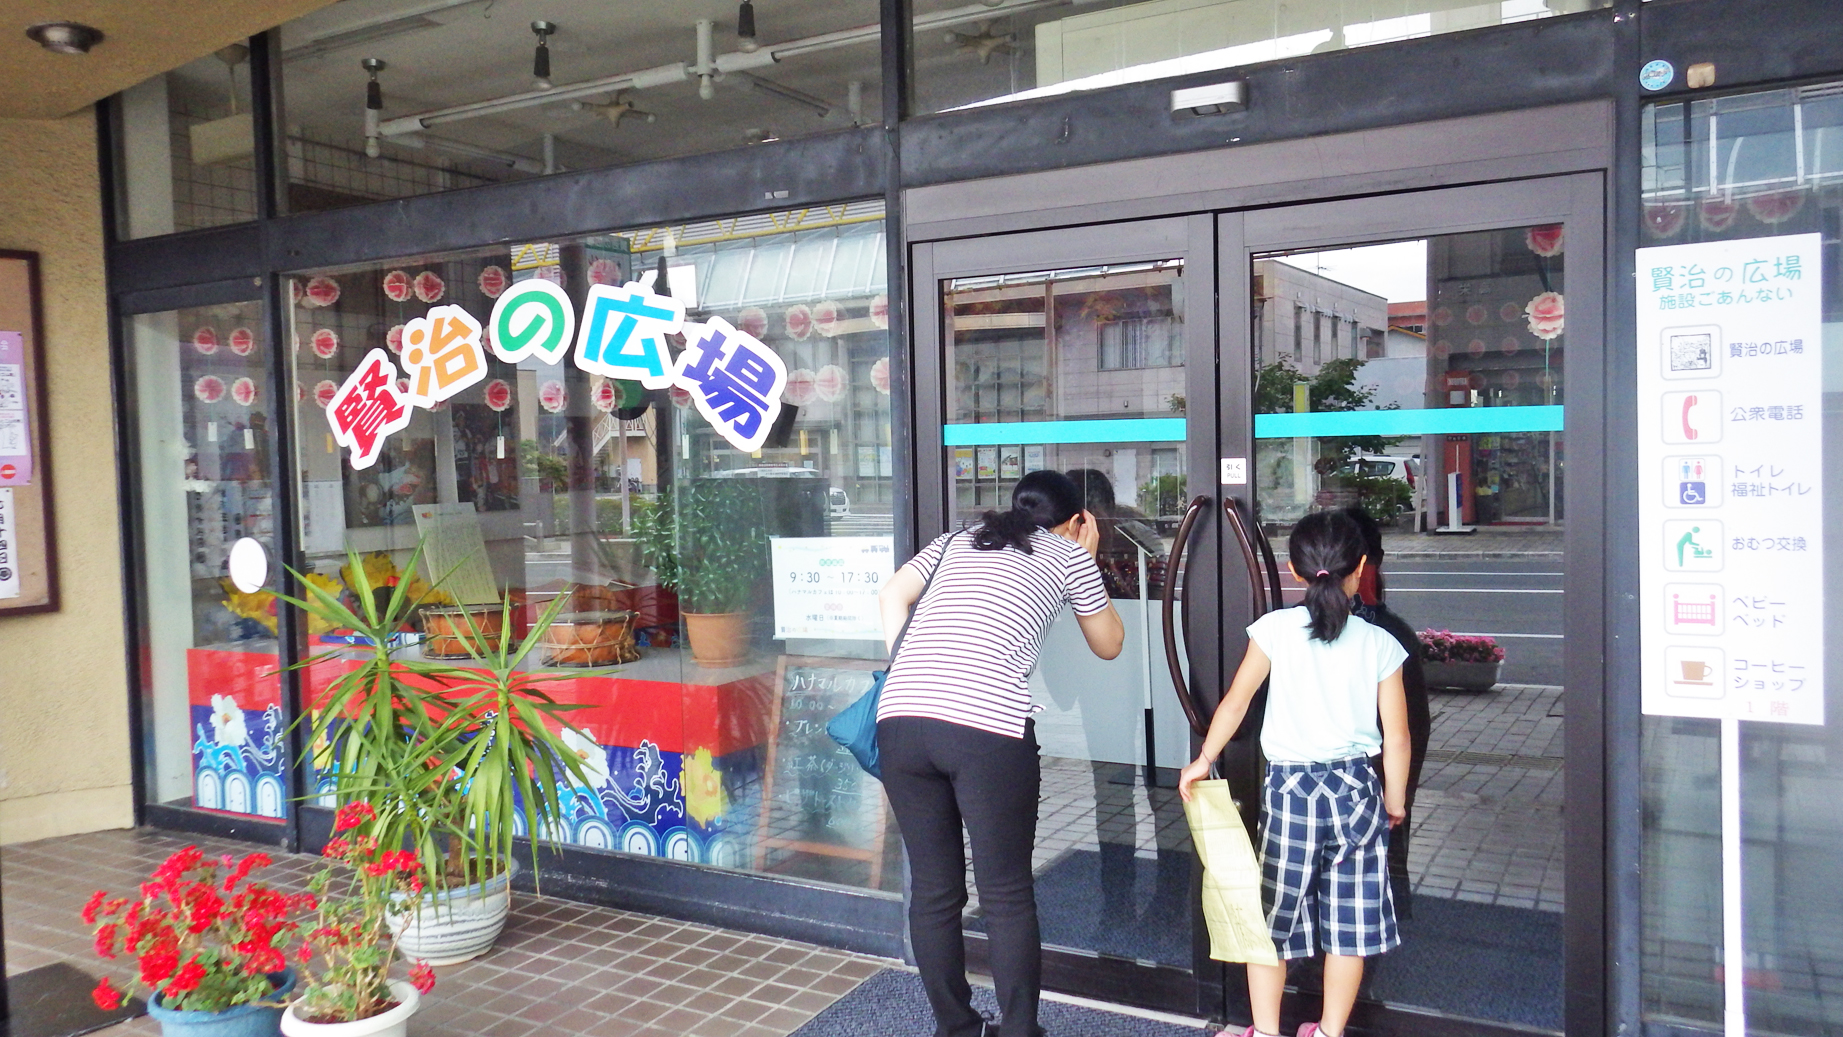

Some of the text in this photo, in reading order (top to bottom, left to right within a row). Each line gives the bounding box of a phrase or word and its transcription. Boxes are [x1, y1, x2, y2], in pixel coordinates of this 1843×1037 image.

[1651, 256, 1803, 292] 賢治の広場
[1659, 287, 1793, 310] 施設ごあんない
[1729, 339, 1804, 358] 賢治の広場
[333, 290, 776, 459] 賢治の広場
[1730, 405, 1804, 422] 公衆電話
[1734, 464, 1785, 479] トイレ
[1731, 482, 1812, 497] 福祉トイレ
[1732, 536, 1807, 552] おむつ交換
[790, 571, 820, 583] 9:30
[841, 571, 879, 583] 17:30
[1733, 595, 1785, 610] ベビー
[1733, 613, 1786, 628] ベッド
[1734, 659, 1805, 673] コーヒー
[792, 673, 870, 693] ハナマルカフ
[1734, 676, 1806, 691] ショップ
